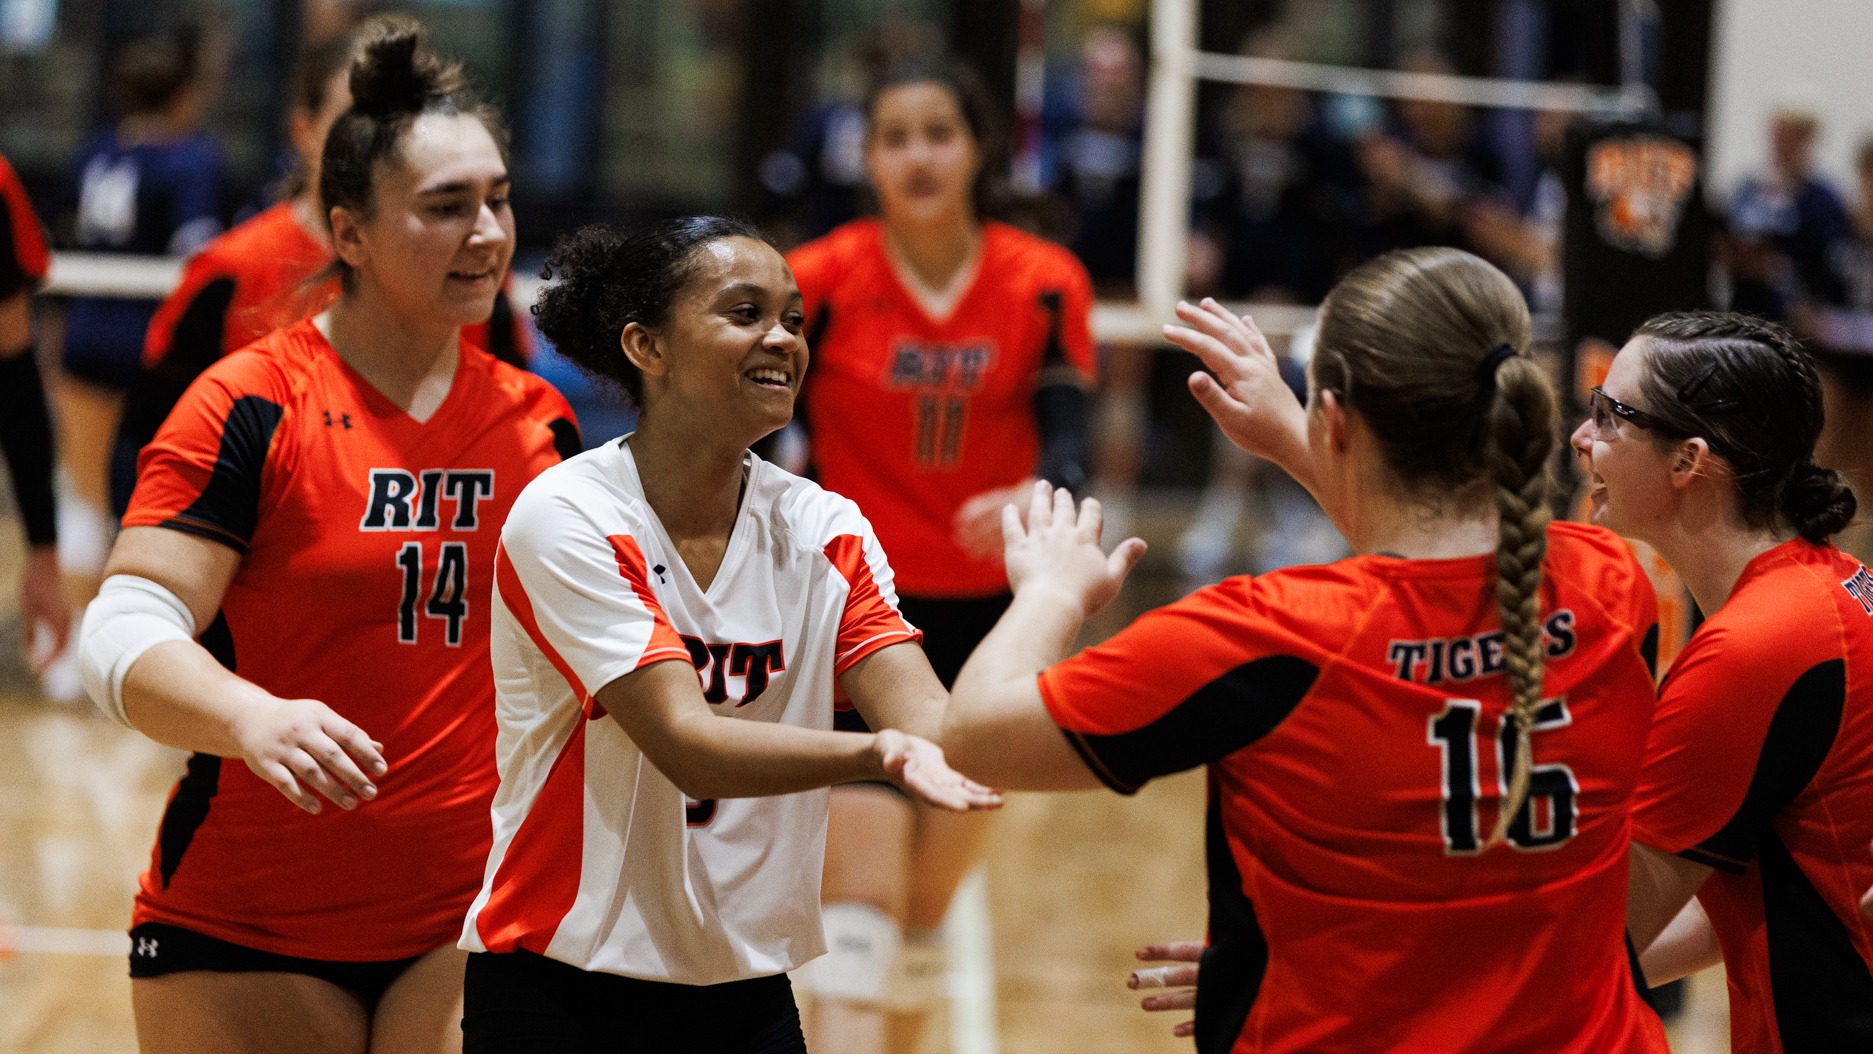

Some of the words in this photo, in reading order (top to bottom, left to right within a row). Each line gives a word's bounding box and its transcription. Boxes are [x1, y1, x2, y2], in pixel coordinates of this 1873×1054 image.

[914, 393, 968, 466] 11
[359, 468, 494, 531] RIT
[396, 542, 468, 646] 14
[1387, 609, 1576, 684] TIGES
[1427, 697, 1580, 854] 16
